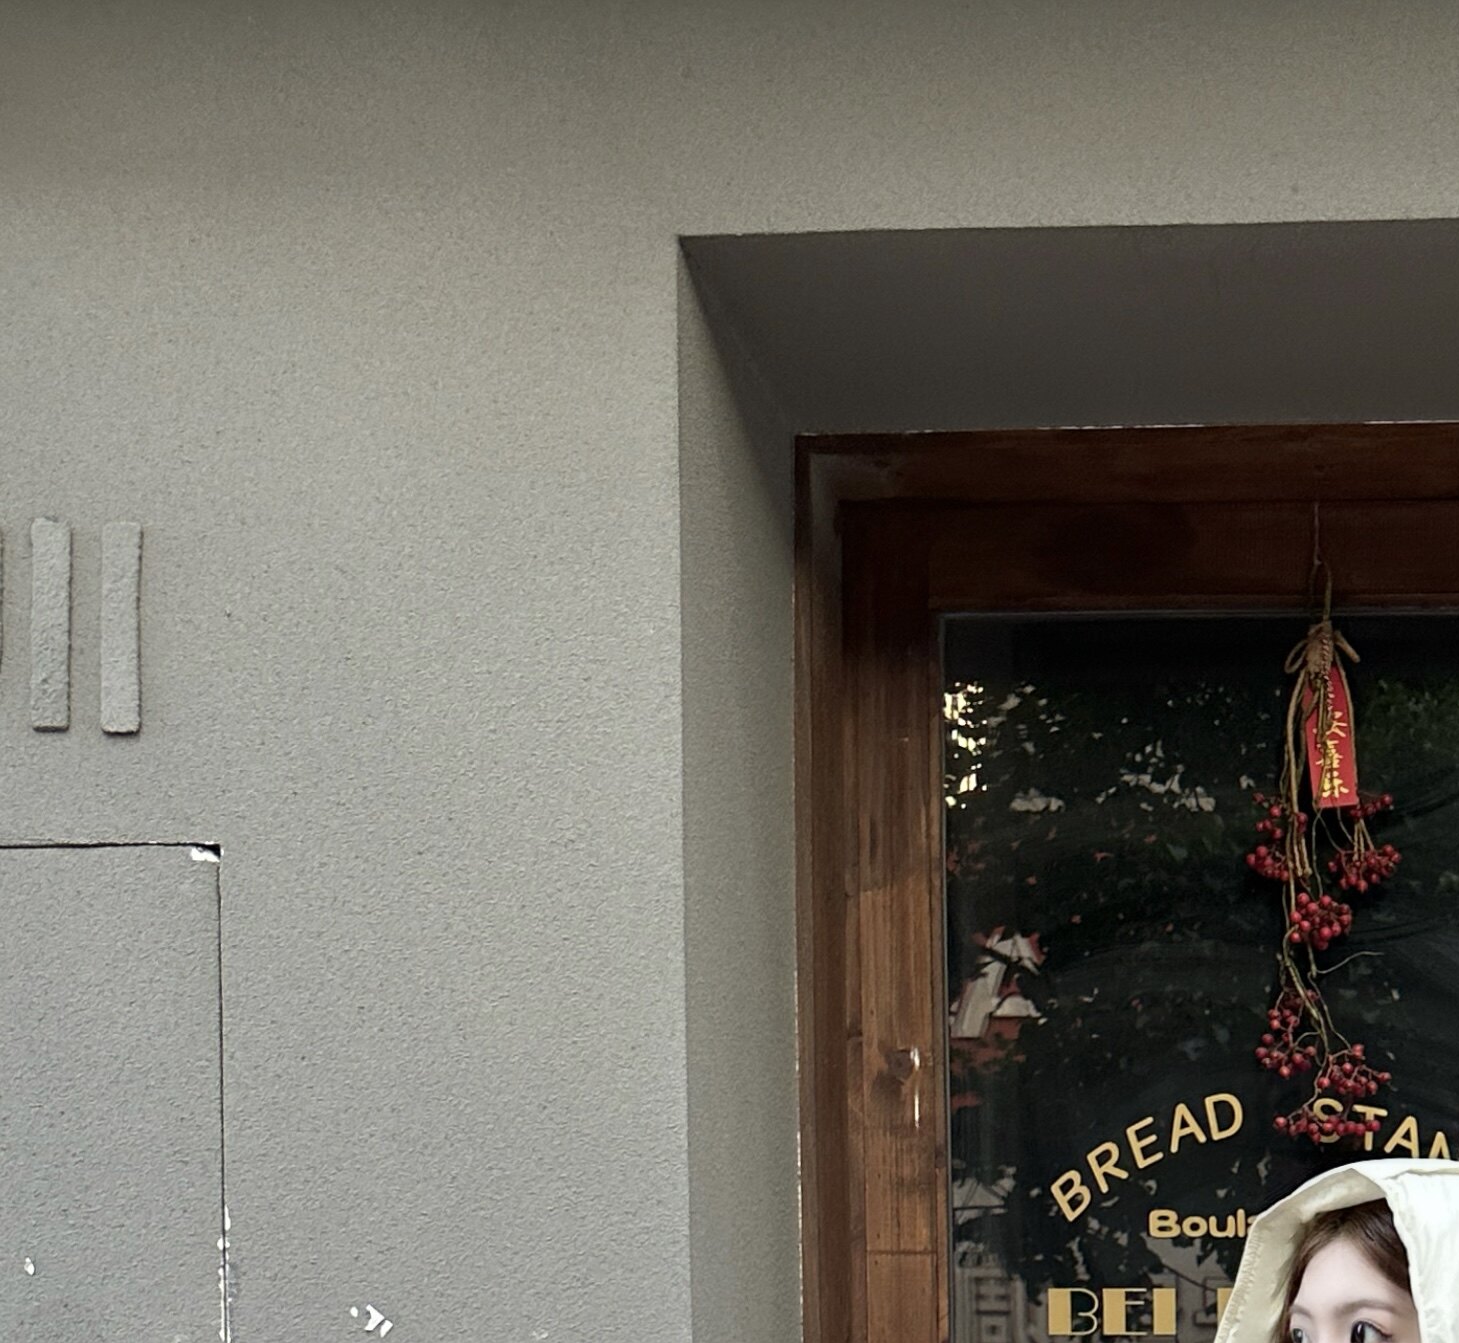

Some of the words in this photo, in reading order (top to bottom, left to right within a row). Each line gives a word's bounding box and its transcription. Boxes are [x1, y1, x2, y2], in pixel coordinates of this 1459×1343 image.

[1050, 1092, 1243, 1222] BREAD
[1148, 1208, 1255, 1238] Boul
[1048, 1288, 1177, 1336] BEI
